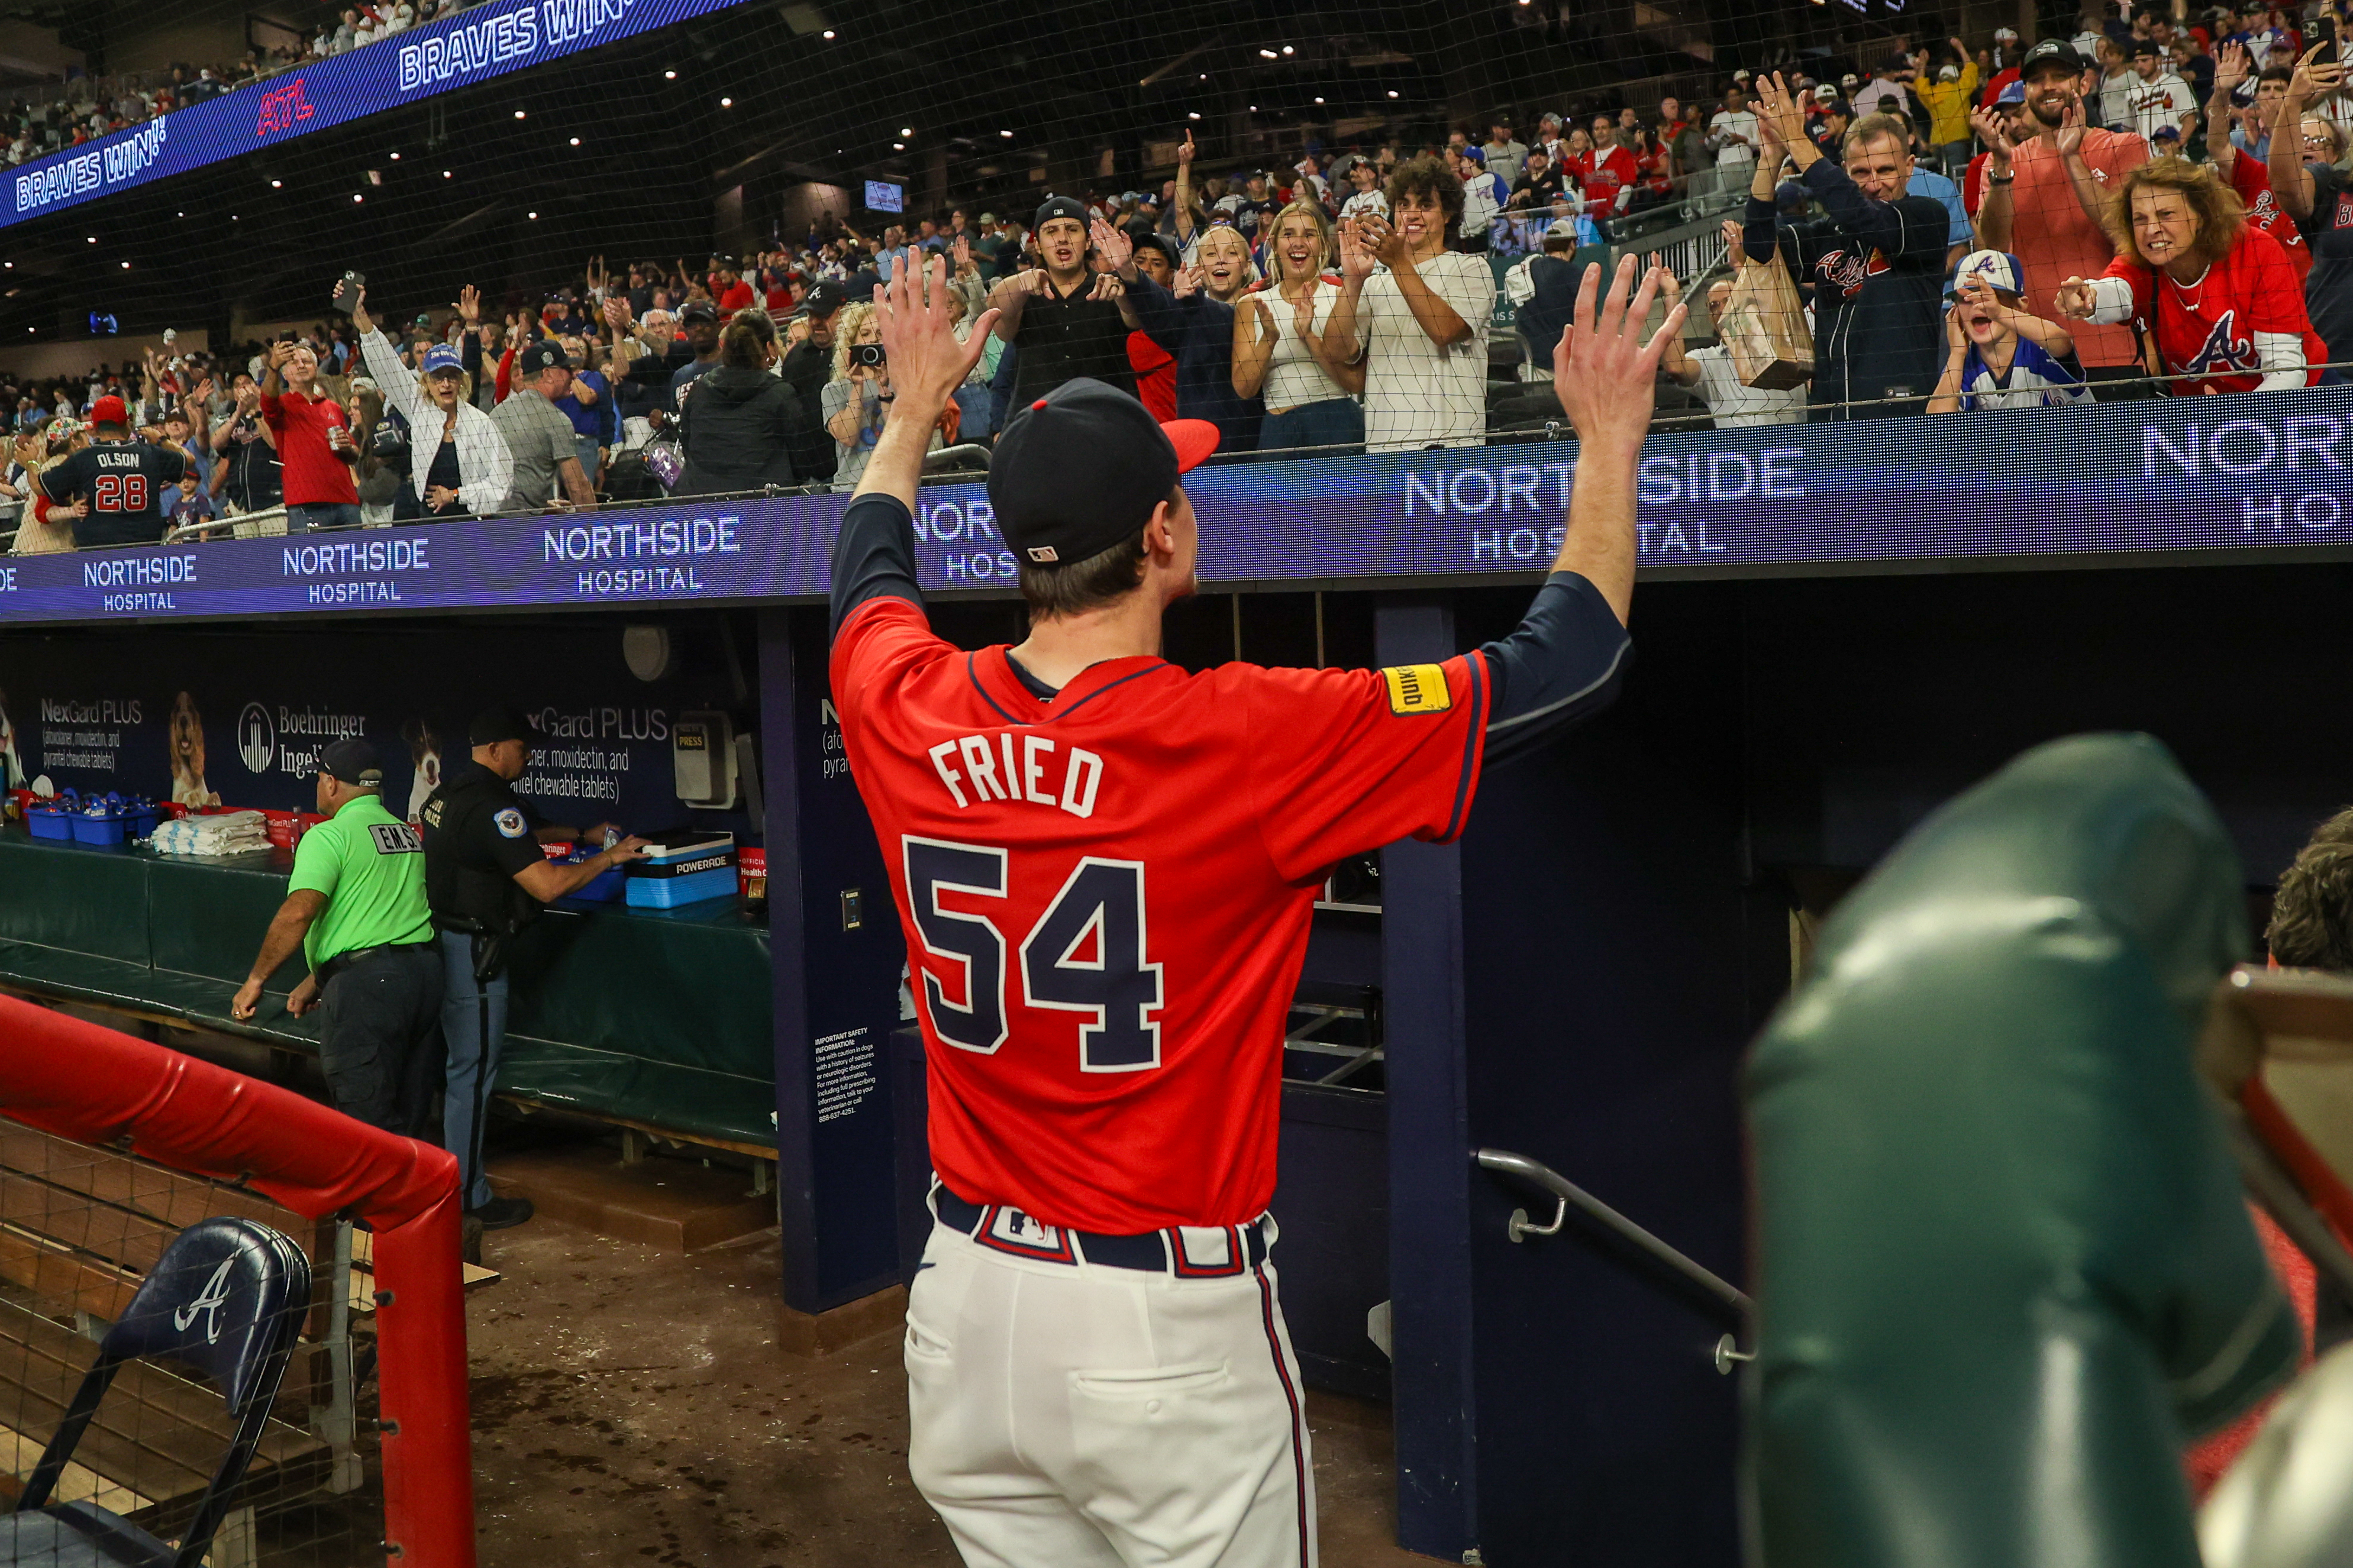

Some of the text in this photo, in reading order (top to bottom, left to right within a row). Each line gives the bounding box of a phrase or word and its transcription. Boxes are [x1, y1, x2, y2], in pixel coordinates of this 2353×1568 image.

[398, 0, 634, 92] BRAVES WIN
[257, 79, 314, 135] ATL
[15, 152, 102, 212] BRAVES
[2336, 203, 2353, 227] B
[2142, 412, 2353, 480] NOR
[96, 451, 140, 468] OLSON
[95, 474, 148, 512] 28
[1403, 447, 1806, 517] NORTSIDE
[912, 499, 995, 541] NOR
[2242, 492, 2342, 533] HO
[544, 515, 741, 562] NORTHSIDE
[1473, 522, 1728, 561] HOSTAL
[283, 539, 430, 576] NORTHSIDE
[946, 551, 1019, 578] HOS
[84, 555, 197, 587] NORTHSIDE
[578, 566, 703, 594] HOSPITAL
[104, 592, 176, 612] HOSPITAL
[308, 580, 402, 603] HOSPITAL
[41, 698, 143, 725] NexGard PLUS
[279, 705, 366, 741] Boehringer
[527, 706, 669, 741] xGard PLUS
[108, 729, 120, 748] and
[679, 736, 702, 746] PRESS
[822, 730, 845, 755] (afo
[91, 750, 115, 774] tablets)
[551, 745, 608, 771] moxidectin,
[609, 747, 629, 771] and
[534, 772, 579, 797] chewable
[580, 775, 620, 805] tablets)
[928, 733, 1104, 819] FRIED
[379, 827, 417, 849] E.M.S.
[676, 855, 727, 875] POWERADE
[741, 867, 767, 877] Health C
[901, 834, 1164, 1074] 54
[815, 1027, 868, 1046] IMPORTANT SAFETY
[815, 1039, 855, 1054] INFORMATION:
[816, 1063, 827, 1072] with
[831, 1059, 848, 1068] history
[854, 1052, 875, 1061] seizures
[826, 1052, 837, 1061] with
[837, 1048, 856, 1057] caution
[861, 1043, 873, 1052] dogs
[822, 1066, 849, 1078] neurologic
[849, 1061, 873, 1072] disorders.
[826, 1078, 839, 1086] more
[817, 1087, 840, 1097] including
[848, 1076, 876, 1089] prescribing
[847, 1089, 856, 1098] talk
[862, 1085, 874, 1094] your
[818, 1103, 847, 1114] veterinarian
[853, 1096, 863, 1104] call
